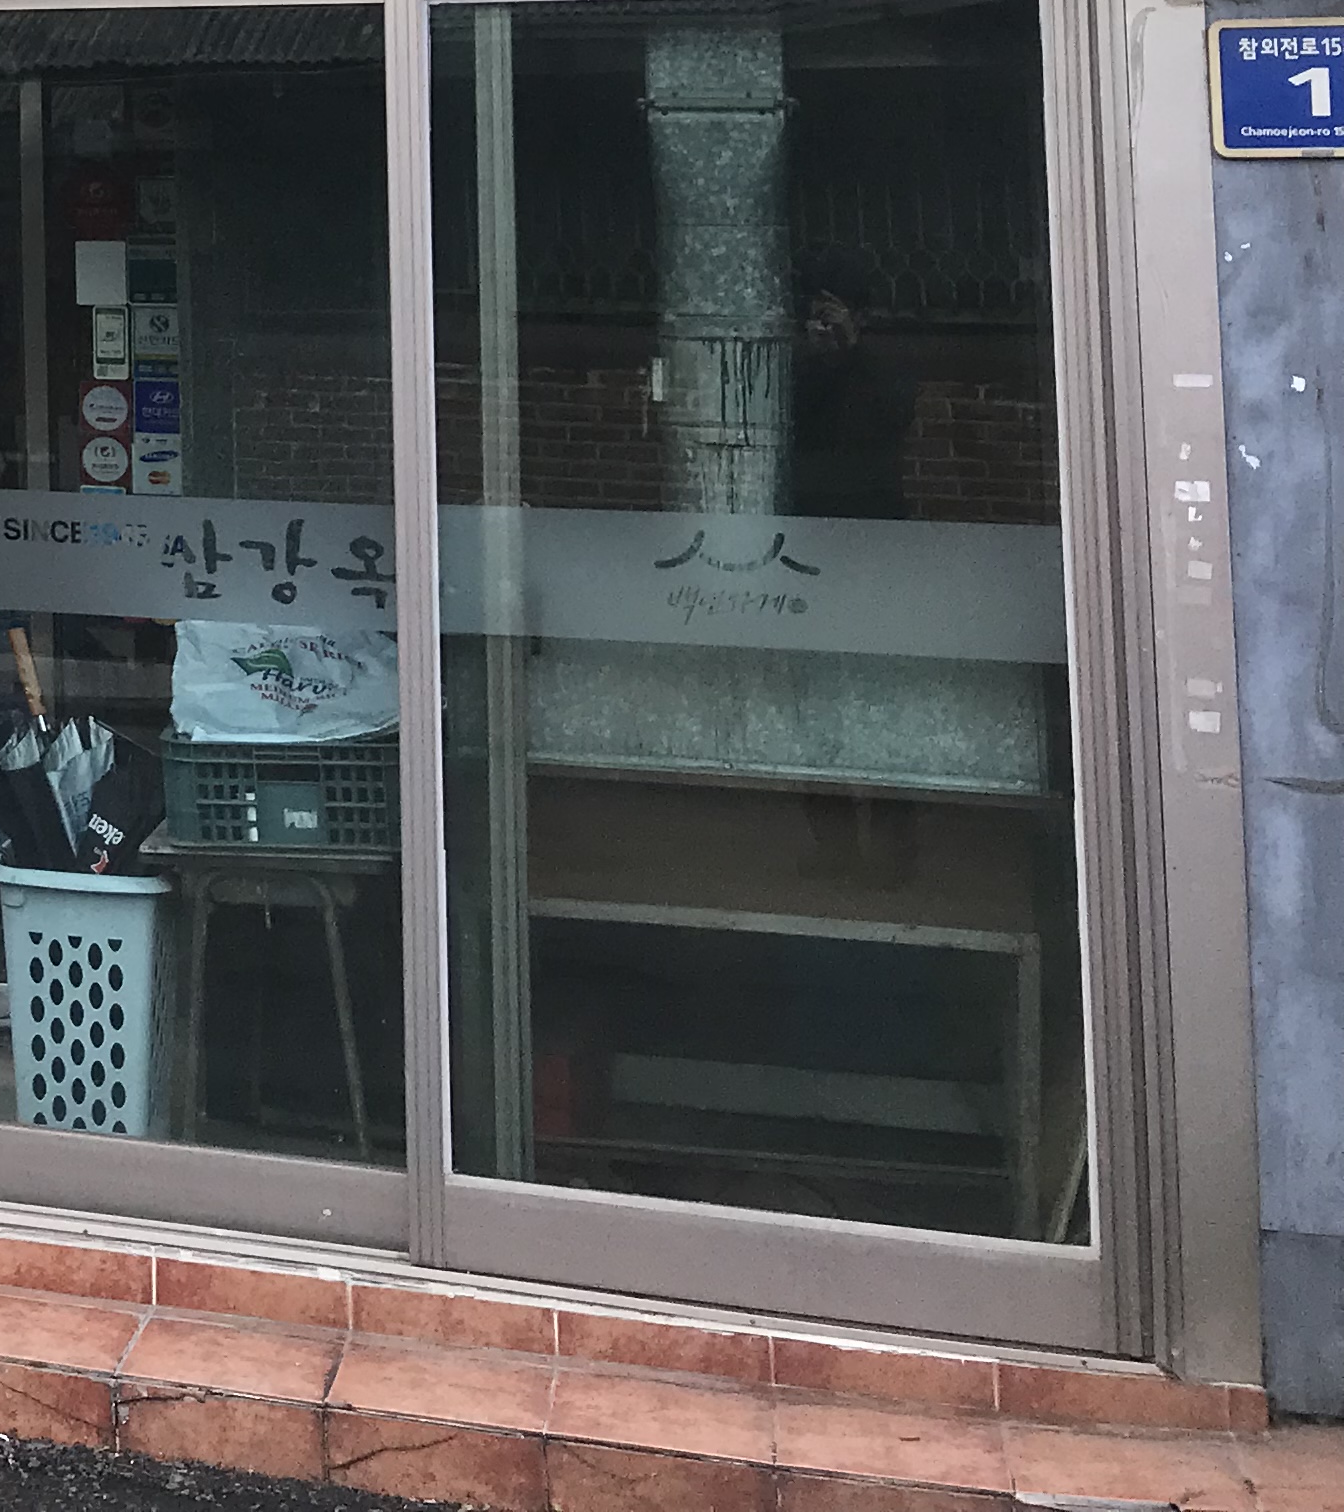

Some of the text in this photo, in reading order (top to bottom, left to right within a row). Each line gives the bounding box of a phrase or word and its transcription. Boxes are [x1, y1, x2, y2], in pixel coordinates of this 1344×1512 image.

[1239, 37, 1344, 61] 참외전로15
[1288, 67, 1331, 117] 1
[164, 518, 396, 609] 삼강옥
